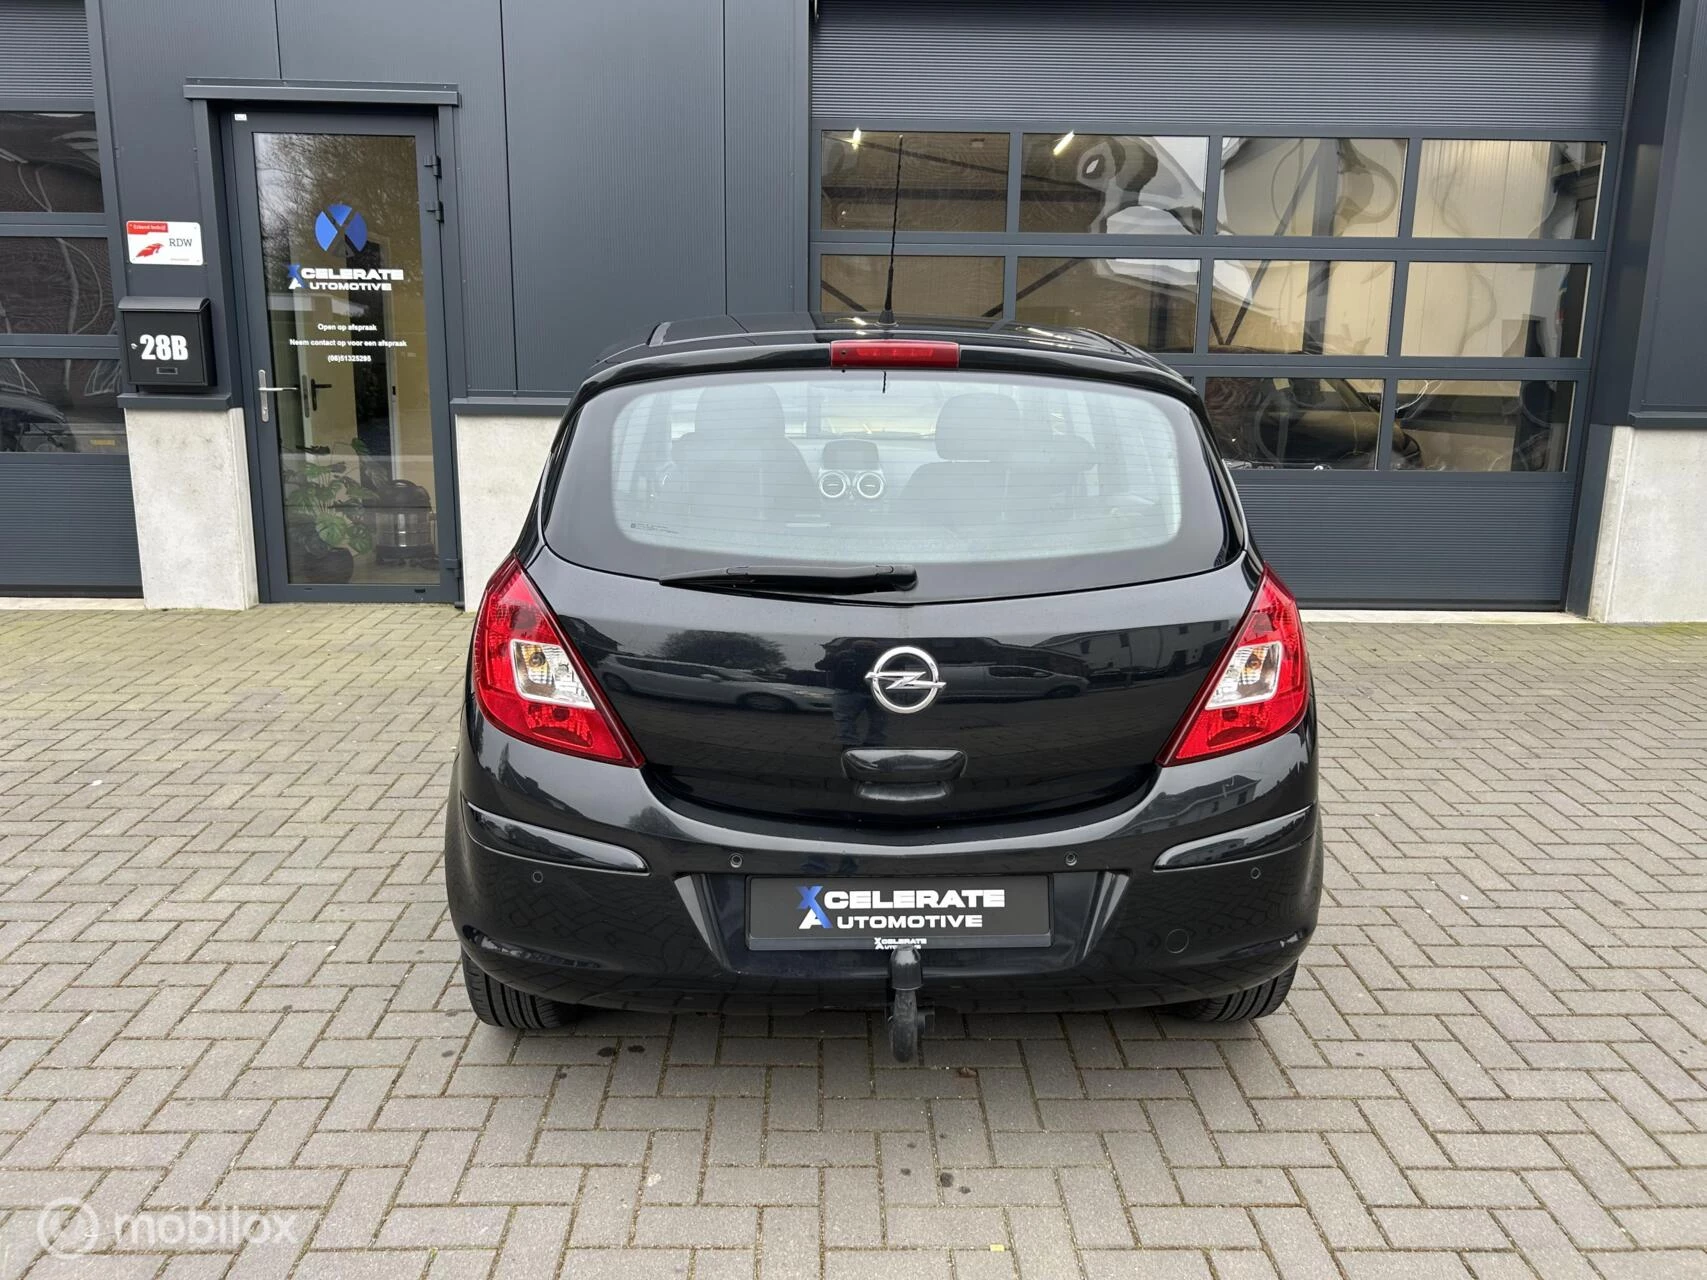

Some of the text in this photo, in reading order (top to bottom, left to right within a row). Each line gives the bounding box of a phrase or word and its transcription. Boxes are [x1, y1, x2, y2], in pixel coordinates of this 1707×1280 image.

[169, 238, 192, 247] RDW
[287, 264, 404, 282] XCELERATE
[289, 278, 392, 291] AUTOMOTIVE
[317, 323, 336, 331] Open
[348, 323, 377, 332] afspraak
[140, 334, 188, 360] 28B
[289, 338, 309, 346] Neem
[378, 339, 407, 348] afspraak
[797, 886, 1005, 916] XCELERATE
[799, 908, 983, 929] AUTOMOTIVE
